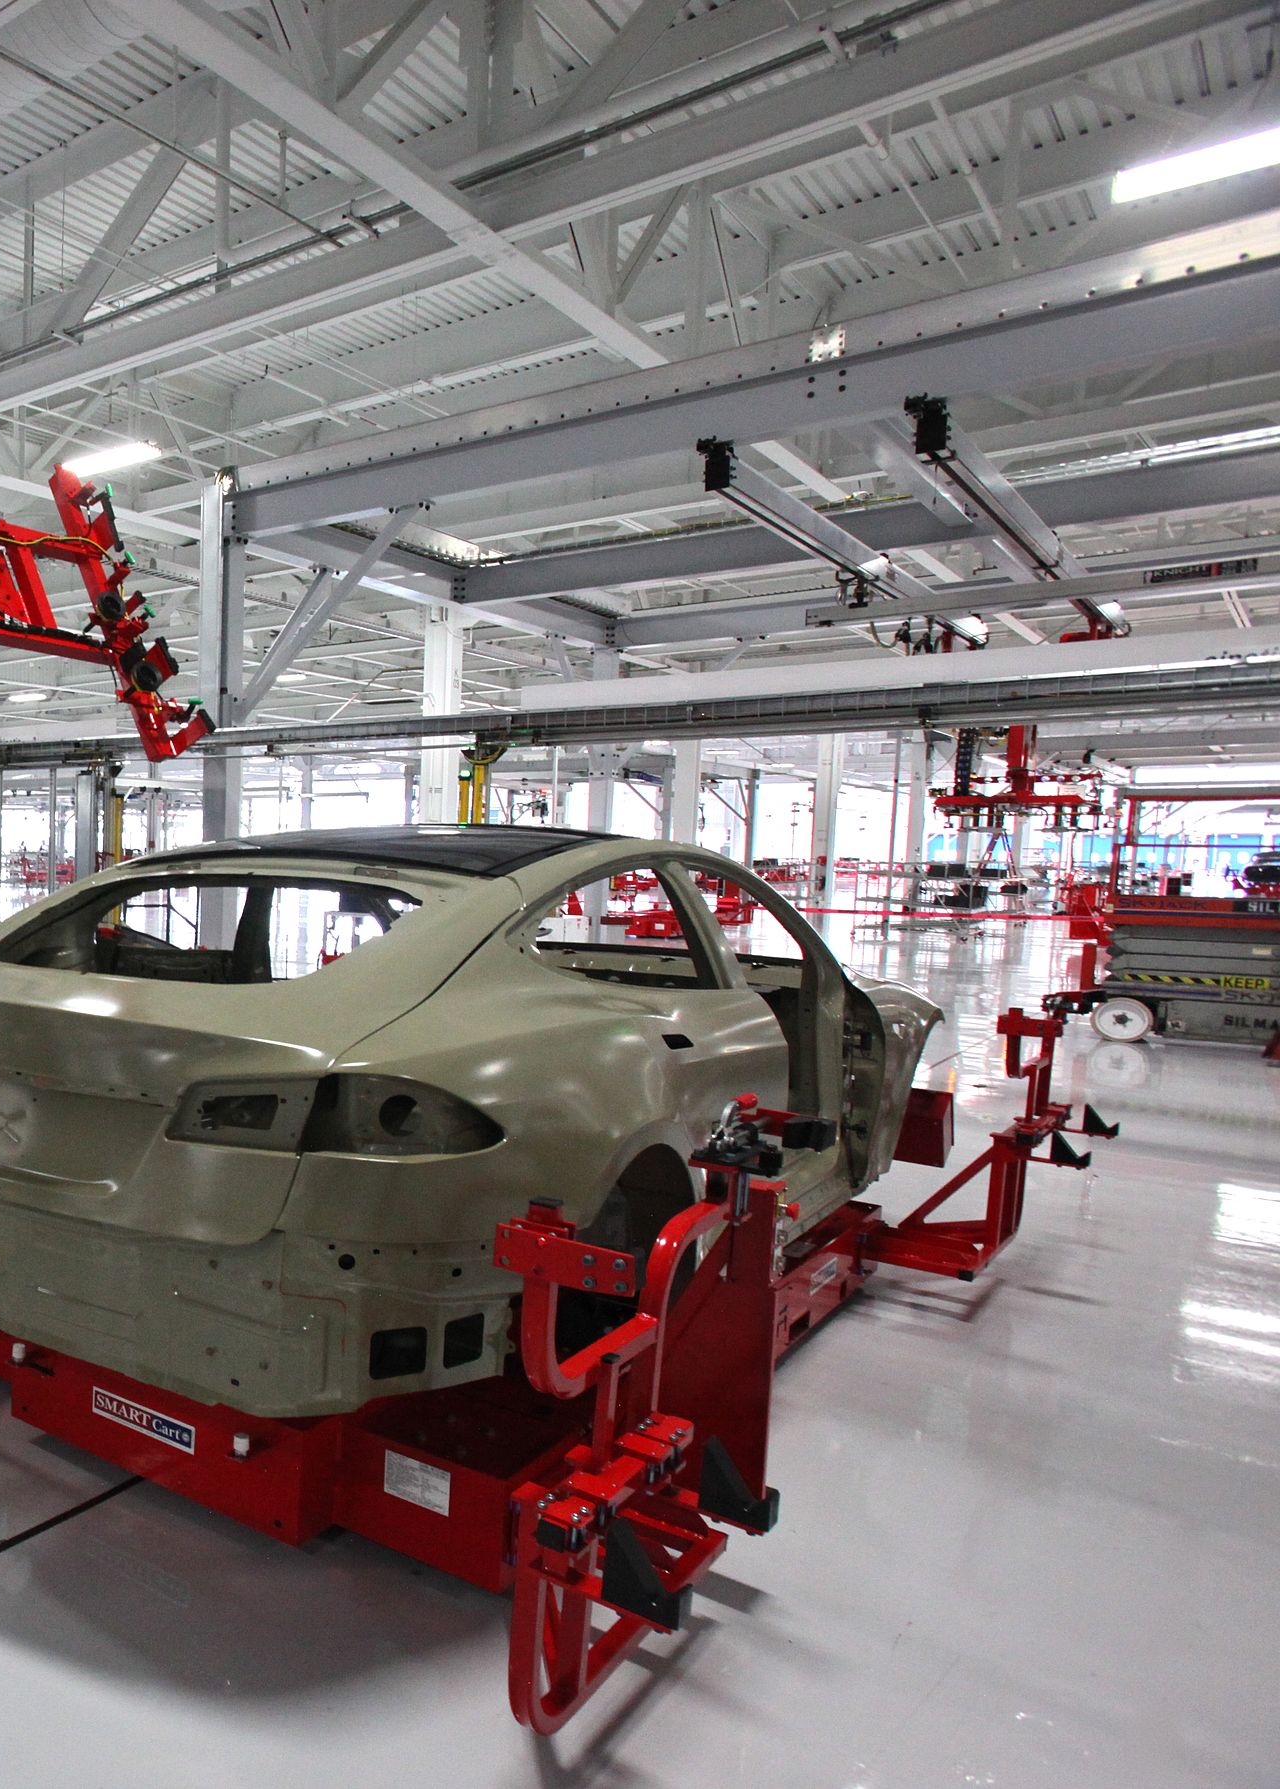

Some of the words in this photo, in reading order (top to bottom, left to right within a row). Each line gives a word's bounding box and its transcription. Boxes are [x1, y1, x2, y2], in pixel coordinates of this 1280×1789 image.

[1248, 901, 1280, 914] SIL
[1223, 976, 1265, 990] KEEP
[1224, 990, 1280, 1003] SKYJ
